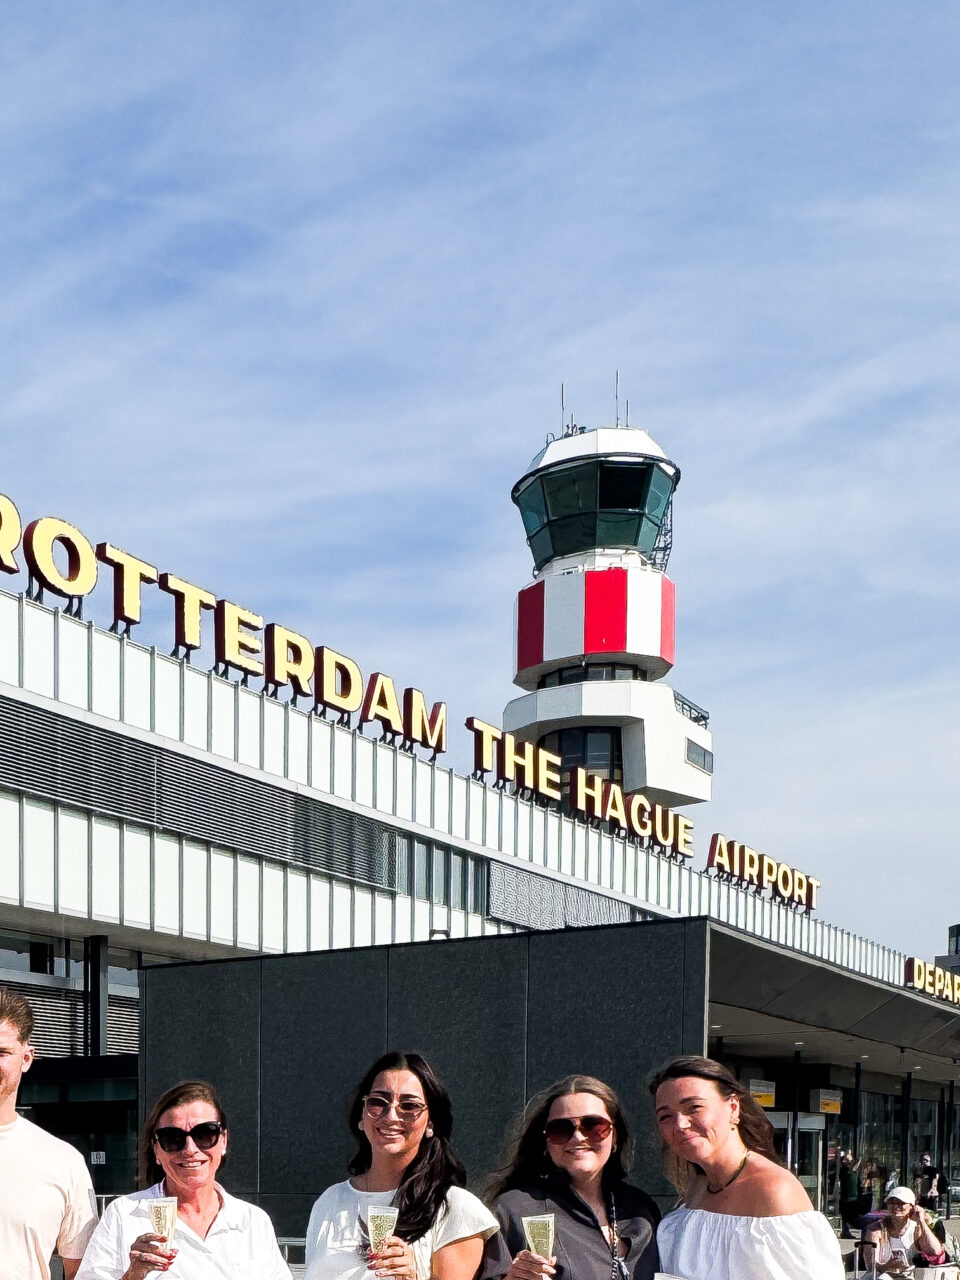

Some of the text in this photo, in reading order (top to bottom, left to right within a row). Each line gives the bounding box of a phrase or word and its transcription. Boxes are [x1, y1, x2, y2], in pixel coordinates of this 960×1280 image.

[465, 716, 562, 801] THE
[570, 765, 695, 859] HAGUE
[707, 832, 821, 911] AIRPORT
